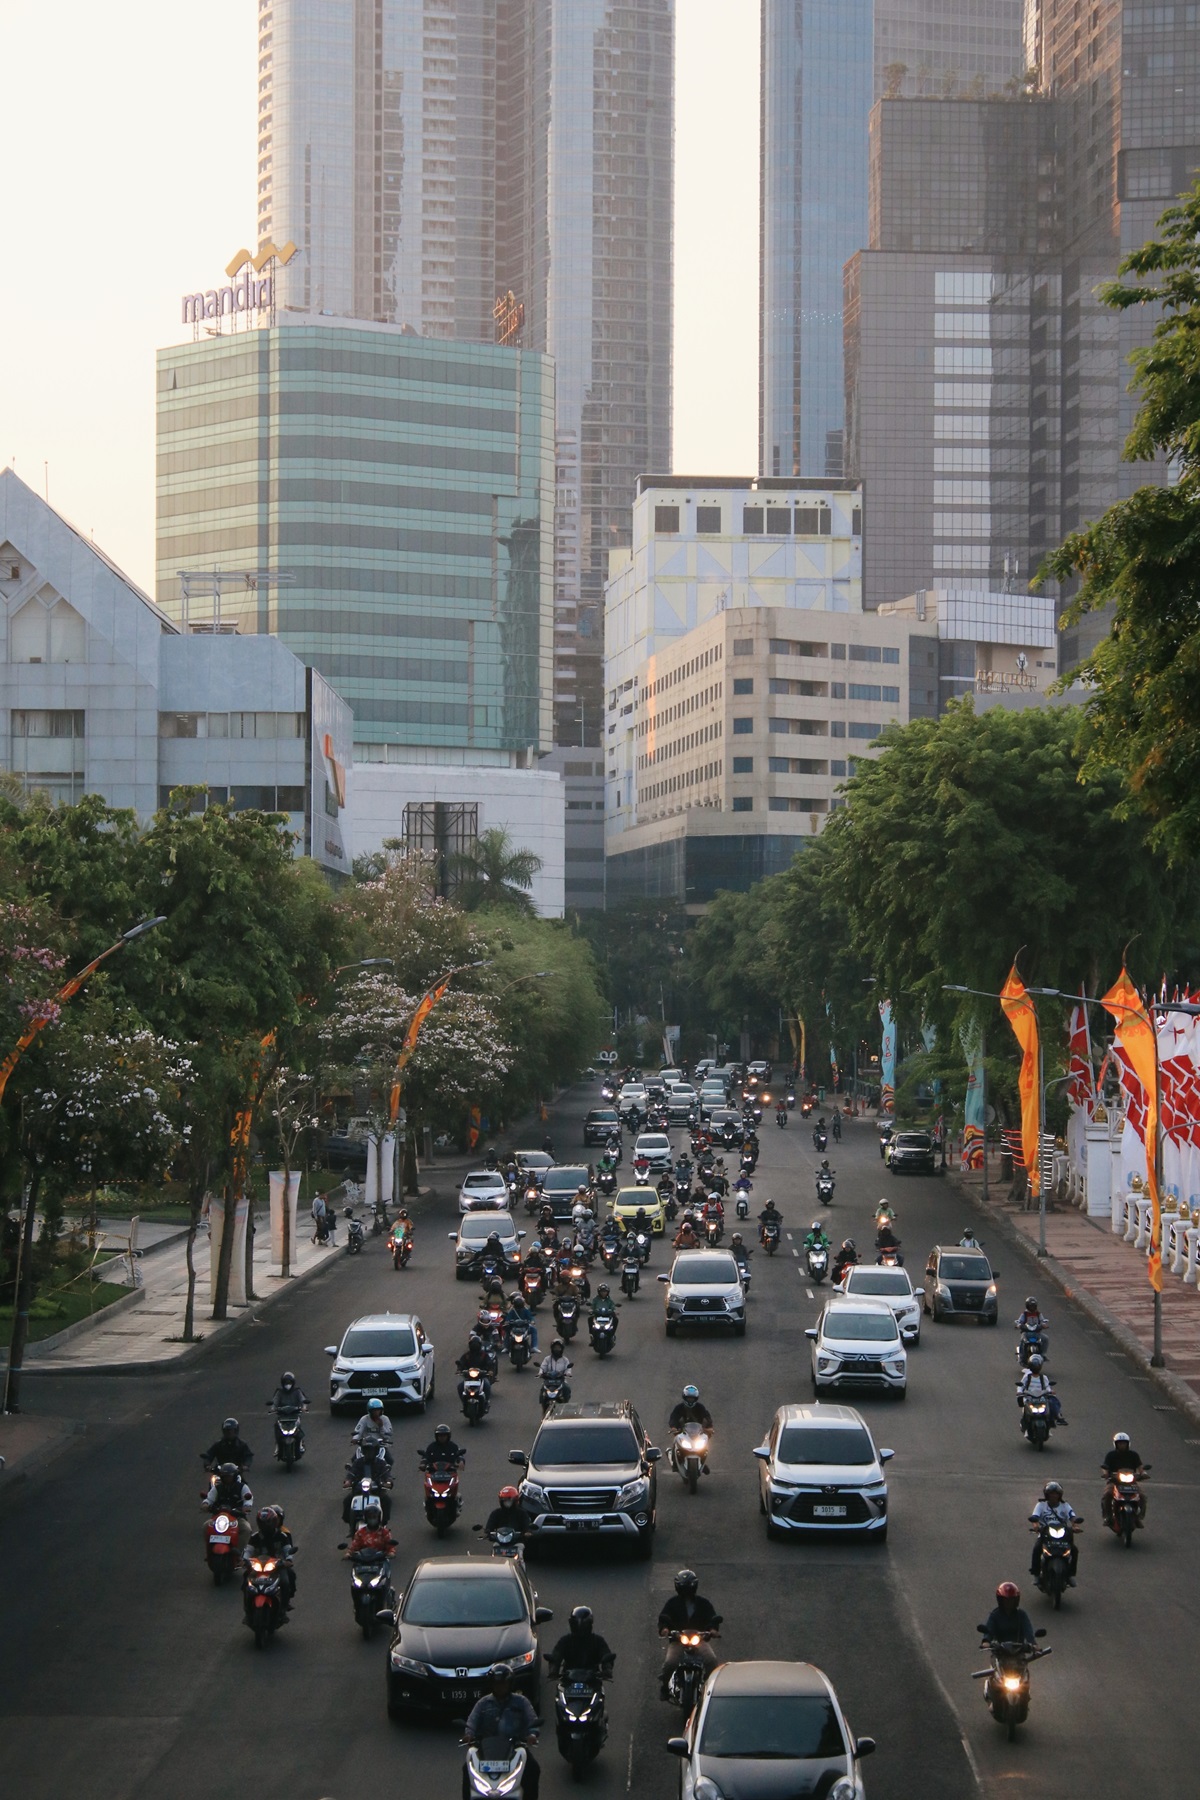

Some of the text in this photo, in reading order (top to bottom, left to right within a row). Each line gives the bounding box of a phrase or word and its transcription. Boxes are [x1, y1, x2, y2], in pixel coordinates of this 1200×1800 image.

[181, 271, 272, 324] mandiri
[441, 1691, 446, 1699] L
[451, 1690, 467, 1699] 1353
